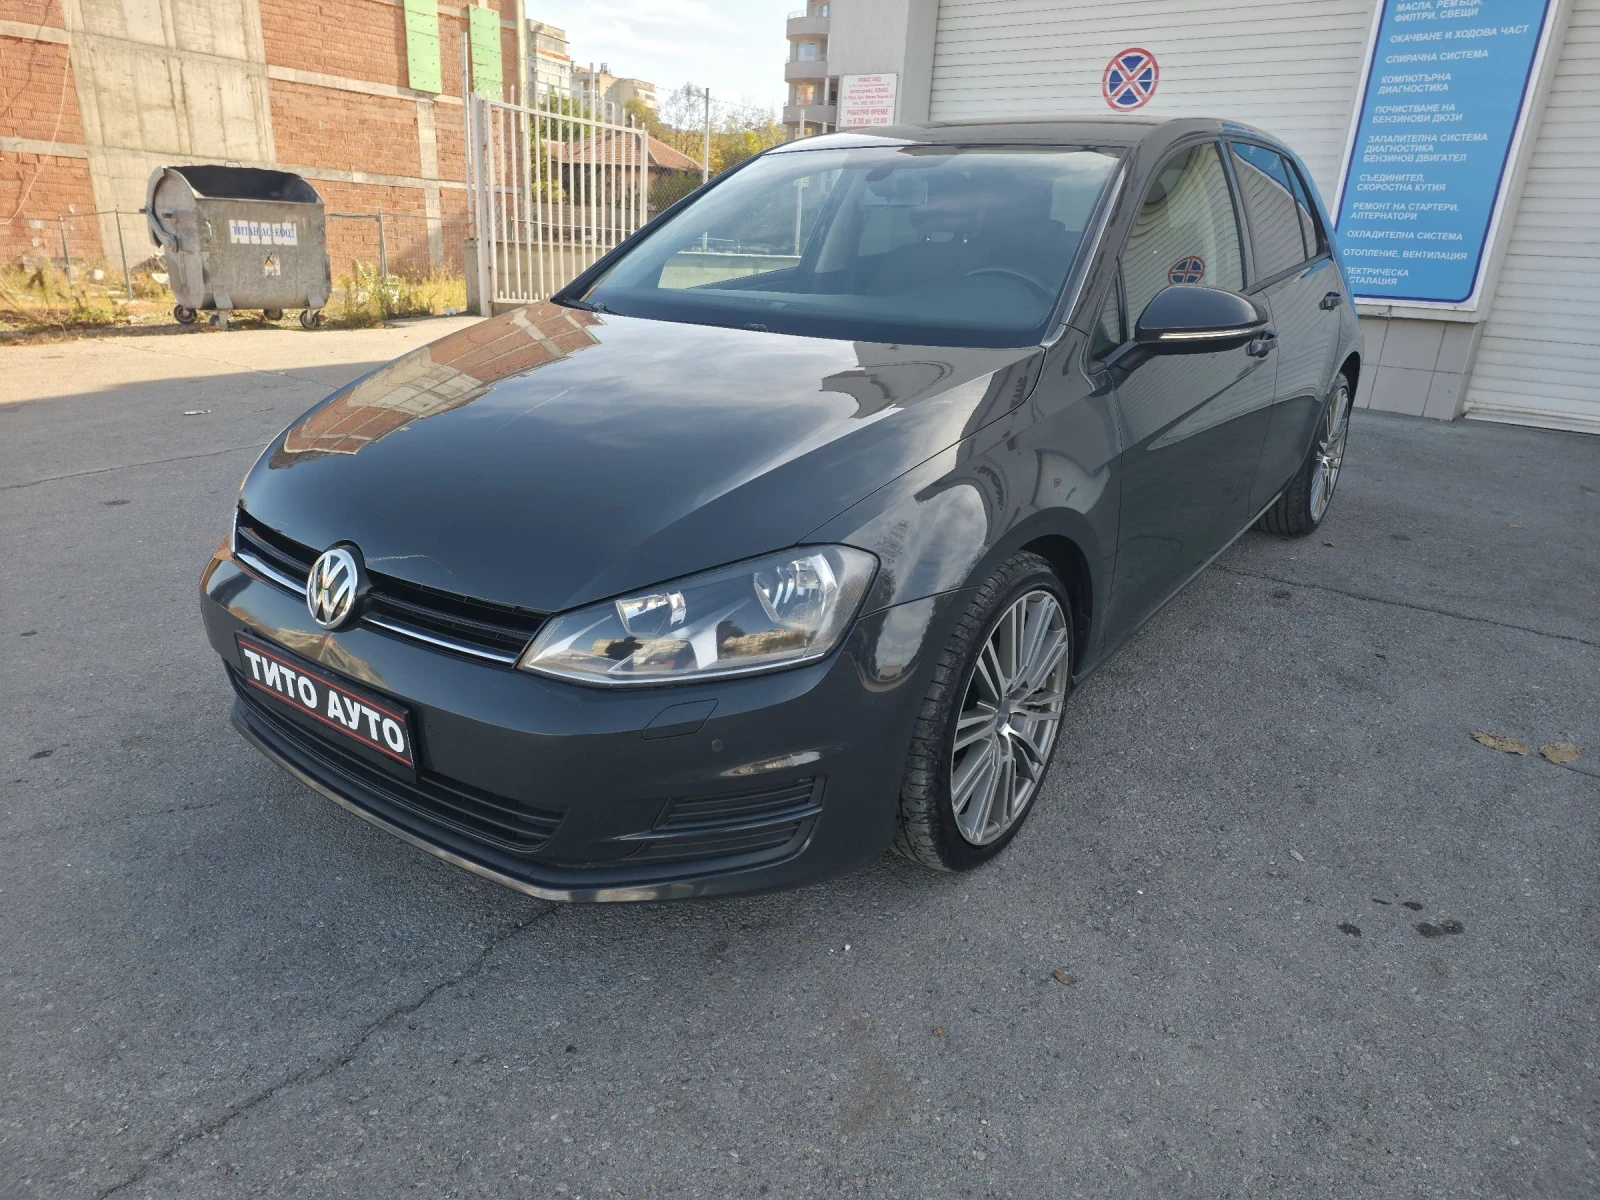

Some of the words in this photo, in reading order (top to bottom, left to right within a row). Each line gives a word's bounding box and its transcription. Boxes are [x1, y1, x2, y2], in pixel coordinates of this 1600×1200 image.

[1396, 2, 1434, 12] МАСЛА,
[1394, 11, 1437, 22] ФИЛТРИ,
[1440, 7, 1479, 19] СВЕЩИ
[1390, 31, 1442, 44] ОКАЧВАНЕ
[1444, 30, 1453, 39] И
[1454, 27, 1497, 39] ХОДОВА
[1501, 24, 1530, 35] ЧАСТ
[1386, 52, 1437, 64] СПИРАЧНА
[1440, 49, 1489, 60] СИСТЕМА
[1381, 72, 1451, 84] КОМПЮТЪРНА
[1378, 83, 1449, 95] ДИАГНОСТИКА
[1375, 104, 1440, 114] ПОЧИСТВАНЕ
[1442, 102, 1456, 112] НА
[1372, 114, 1430, 124] БЕНЗИНОВИ
[1432, 113, 1463, 124] ДЮЗИ
[1368, 134, 1437, 144] ЗАПАЛИТЕЛНА
[1440, 133, 1488, 142] СИСТЕМА
[1365, 144, 1434, 154] ДИАГНОСТИКА
[1363, 154, 1416, 163] БЕНЗИНОВ
[1416, 153, 1466, 164] ДВИГАТЕЛ
[1357, 183, 1413, 192] СКОРОСТНА
[1414, 183, 1446, 192] КУТИЯ
[1353, 202, 1391, 211] РЕМОНТ
[1393, 202, 1406, 211] НА
[1408, 202, 1460, 212] СТАРТЕРИ,
[1350, 211, 1417, 220] АЛТЕРНАТОРИ
[1347, 230, 1415, 240] ОХЛАДИТЕЛНА
[1417, 232, 1463, 241] СИСТЕМА
[1402, 250, 1468, 260] ВЕНТИЛАЦИЯ
[244, 648, 318, 709] ТИТО
[328, 689, 404, 752] АУТО
